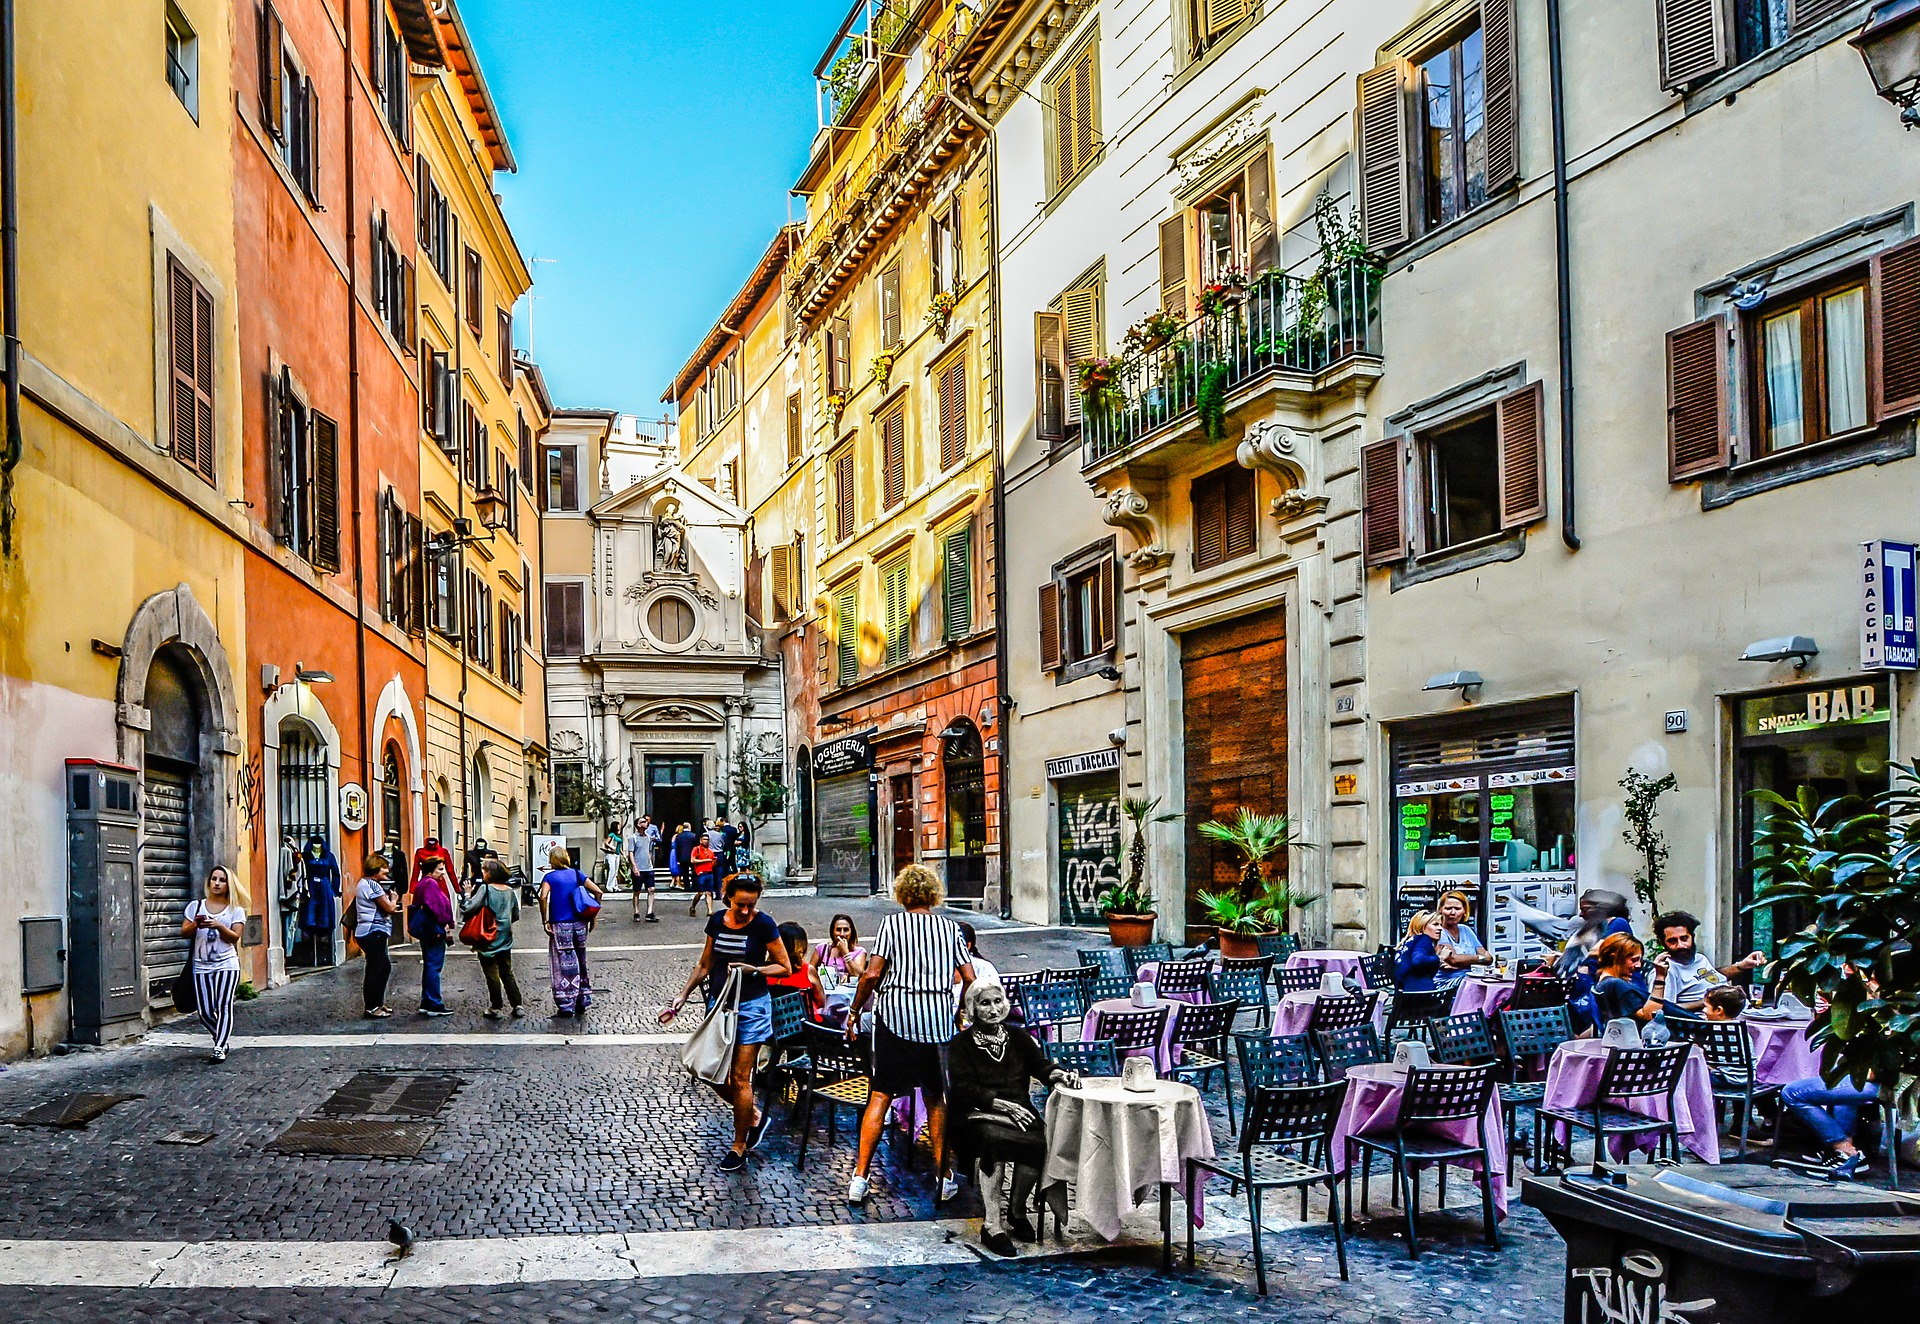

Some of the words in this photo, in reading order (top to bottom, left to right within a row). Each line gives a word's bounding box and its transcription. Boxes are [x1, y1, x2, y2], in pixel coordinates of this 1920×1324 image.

[1863, 543, 1877, 658] TABACCHI
[1884, 548, 1911, 631] T
[1885, 646, 1915, 663] TABACCHI
[1807, 686, 1875, 724] BAR
[1666, 714, 1684, 727] 90
[813, 739, 865, 769] YOGURTERIA
[1047, 758, 1074, 777] FILETTI
